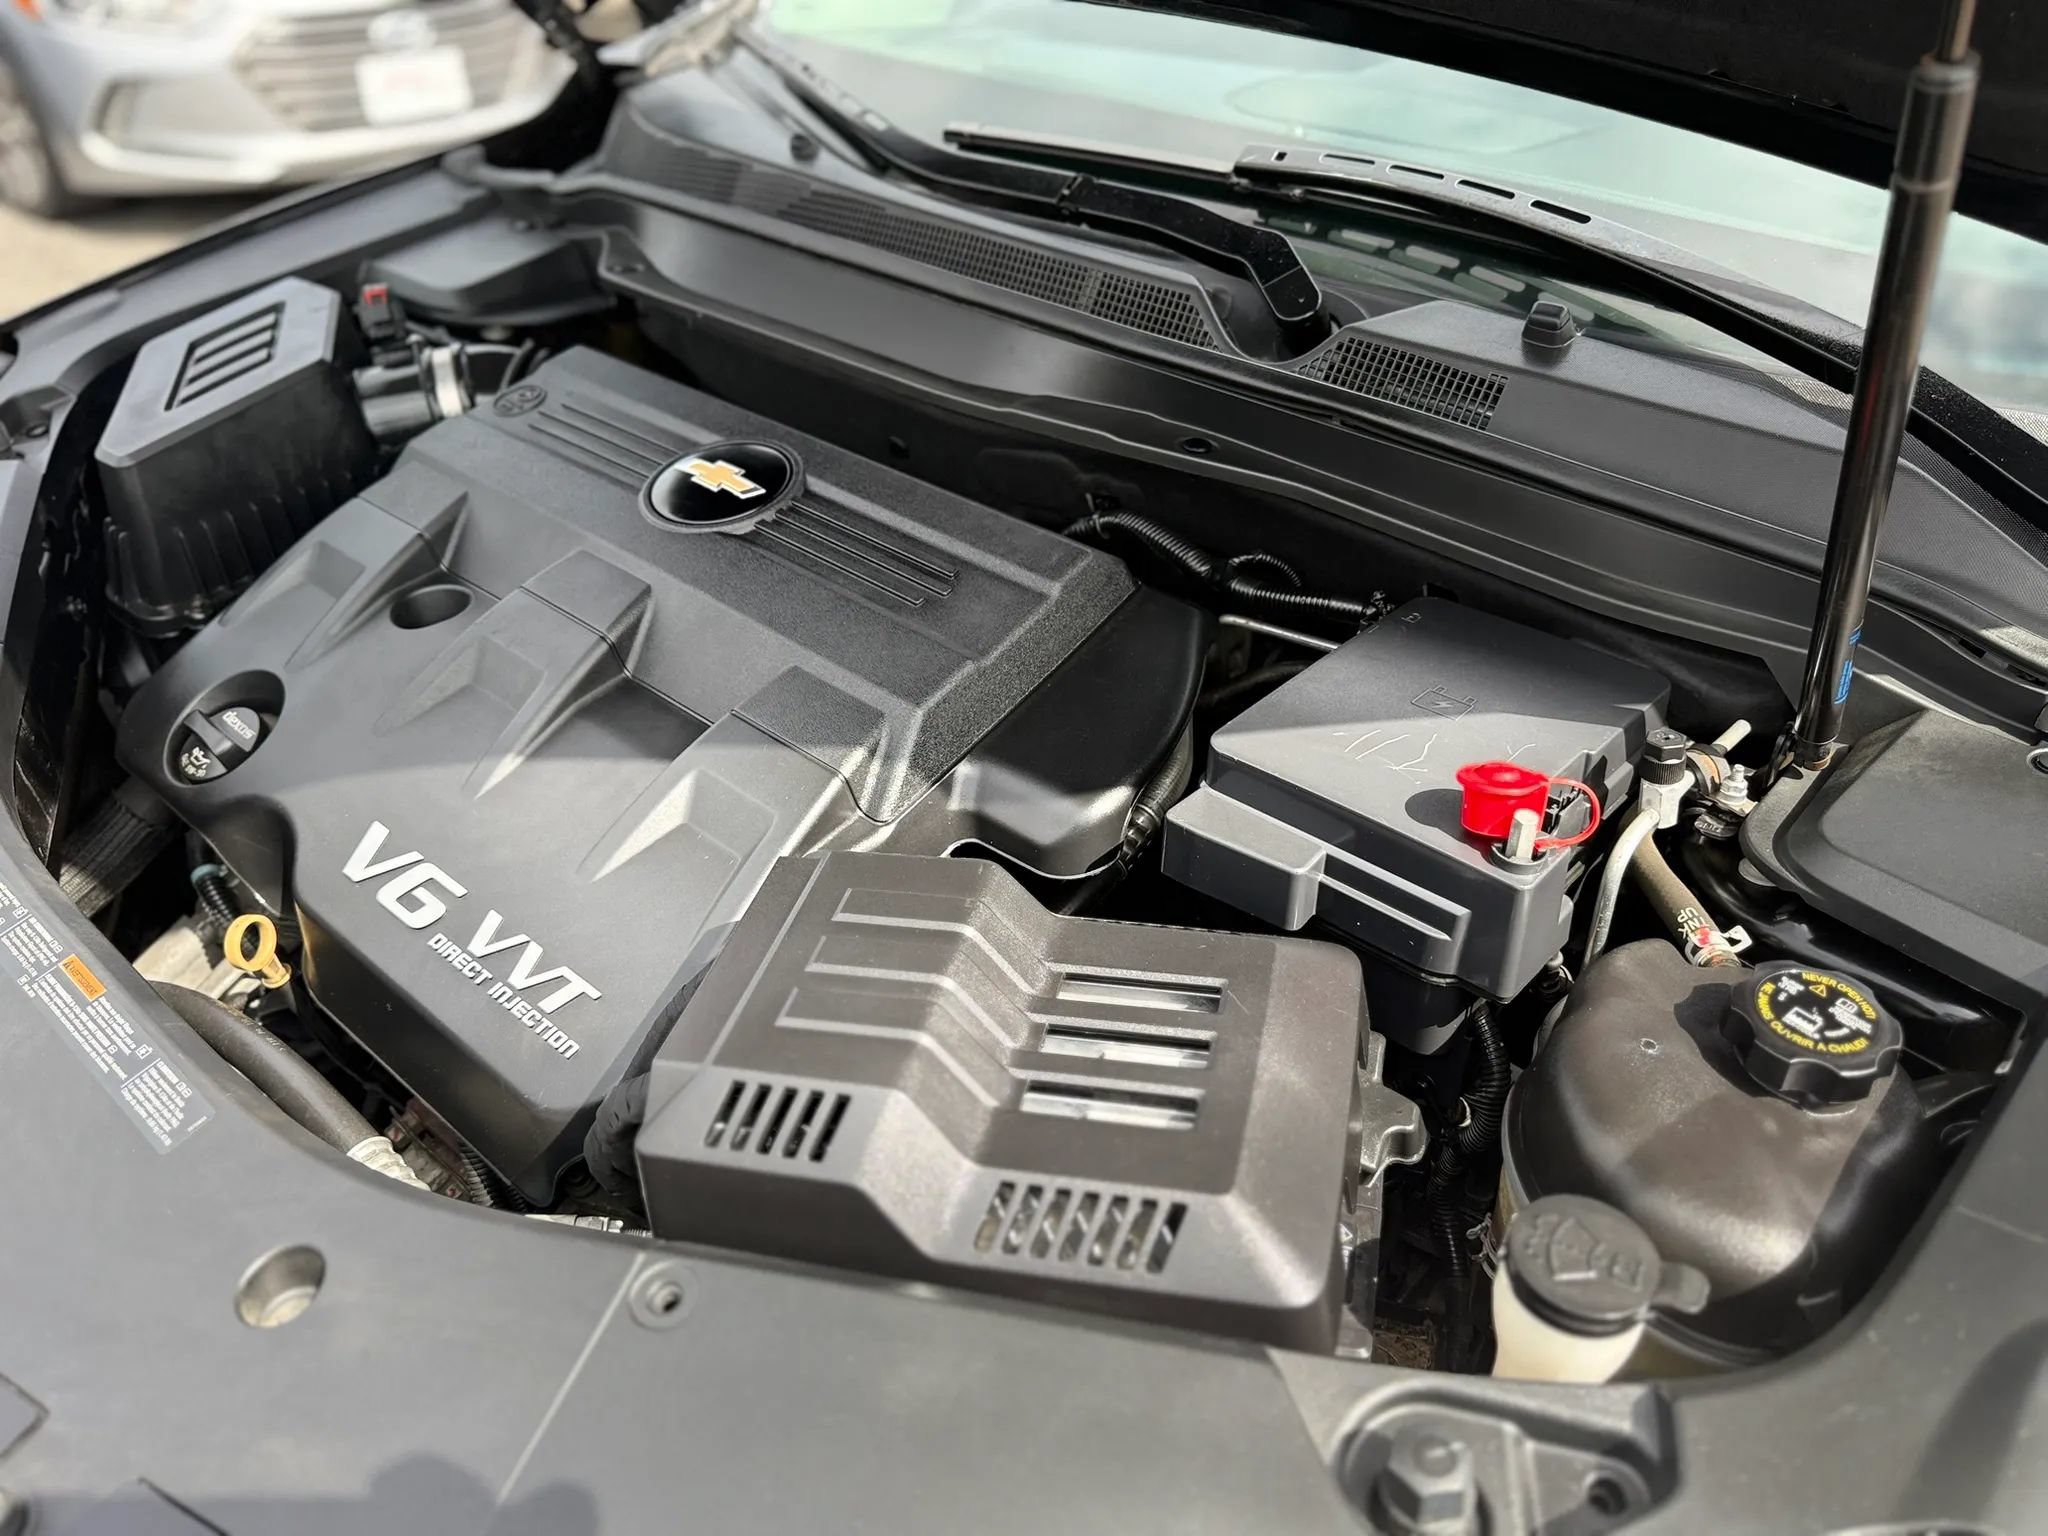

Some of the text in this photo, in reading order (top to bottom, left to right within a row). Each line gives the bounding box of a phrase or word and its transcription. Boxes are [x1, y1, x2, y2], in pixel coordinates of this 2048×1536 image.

[222, 711, 256, 740] dexos
[342, 820, 603, 1015] V6 VVT
[427, 932, 581, 1060] DIRECT INJECTION
[1802, 972, 1837, 988] NEVER
[1837, 983, 1861, 1001] OPEN
[1770, 1020, 1815, 1050] OUVRIR
